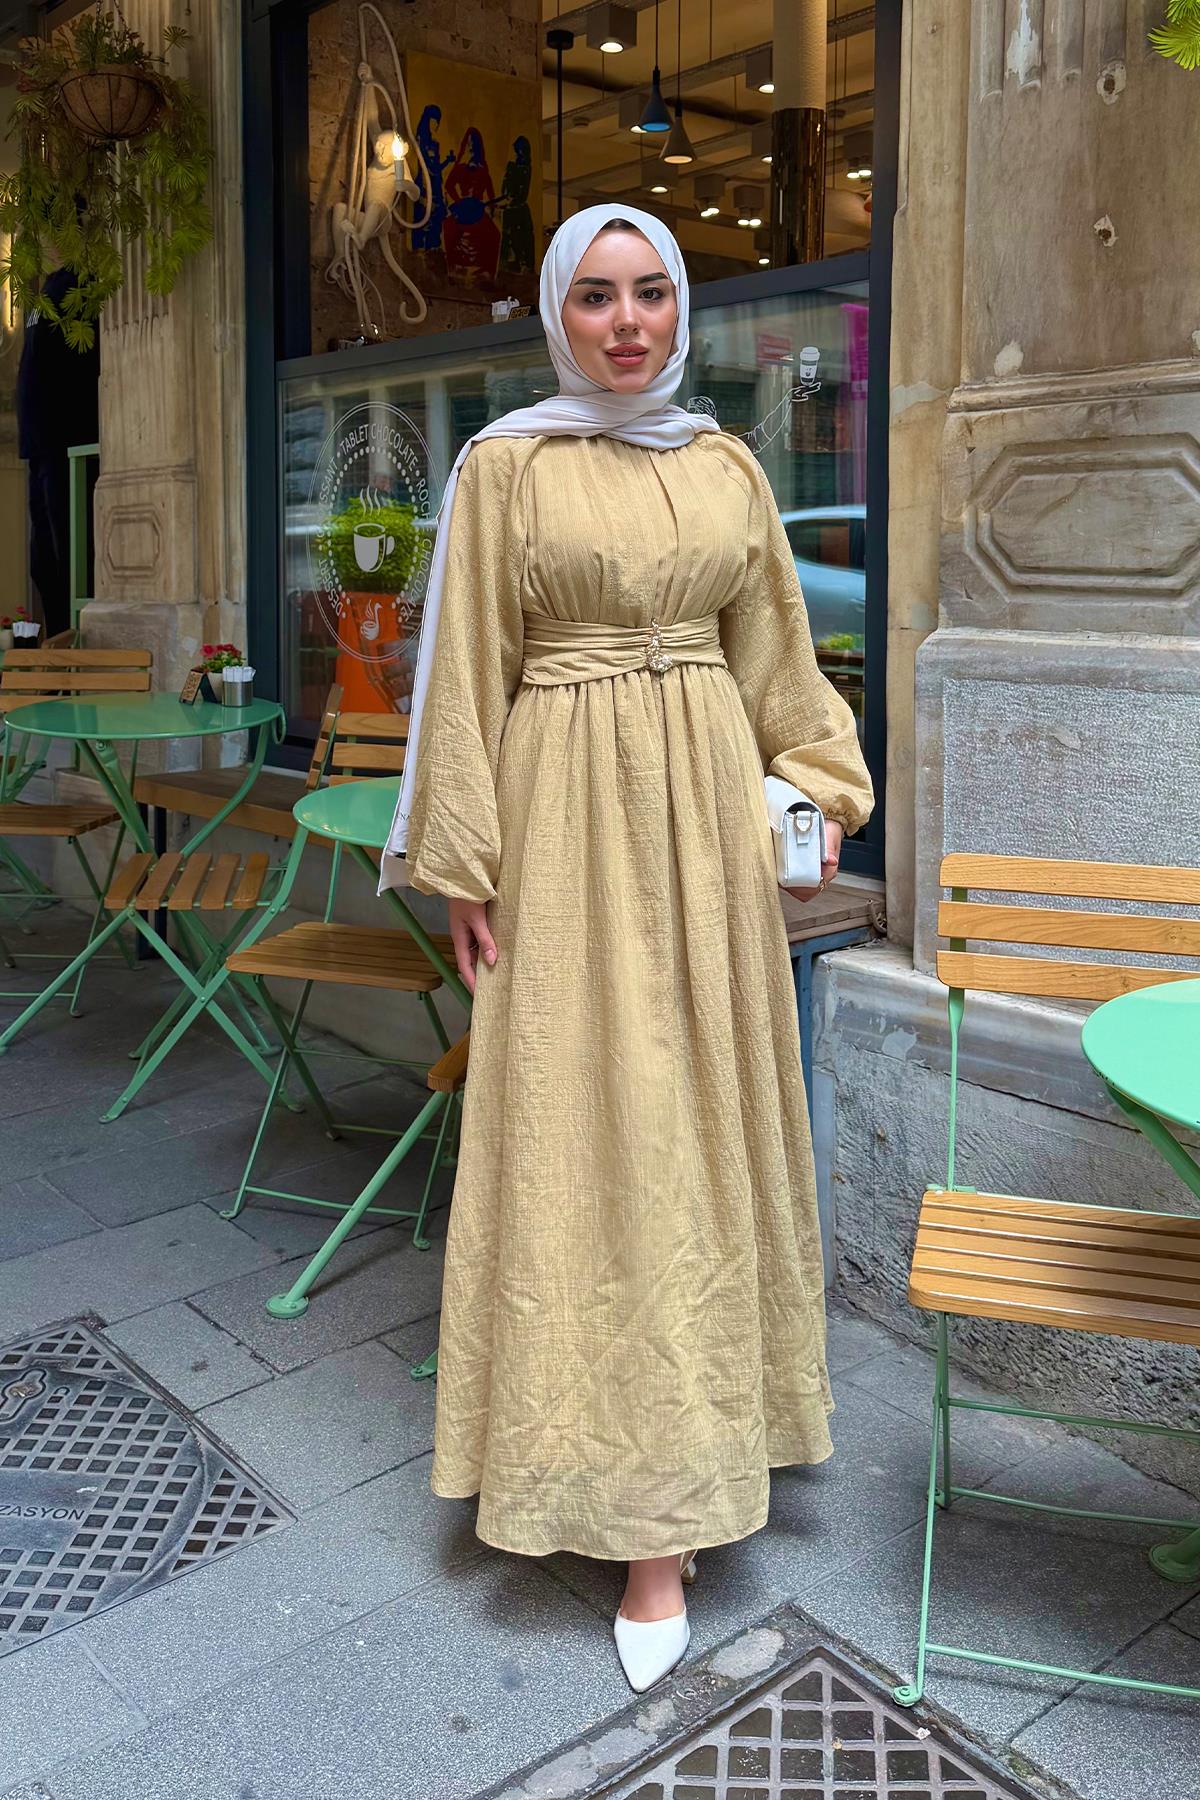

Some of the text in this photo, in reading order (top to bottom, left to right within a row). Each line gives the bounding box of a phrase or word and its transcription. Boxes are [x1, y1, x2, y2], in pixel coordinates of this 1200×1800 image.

[339, 423, 419, 472] TABLET CHOCOLATE
[316, 456, 338, 537] CSSANT
[318, 559, 343, 617] DESSERT
[0, 1504, 85, 1521] ZASYON
